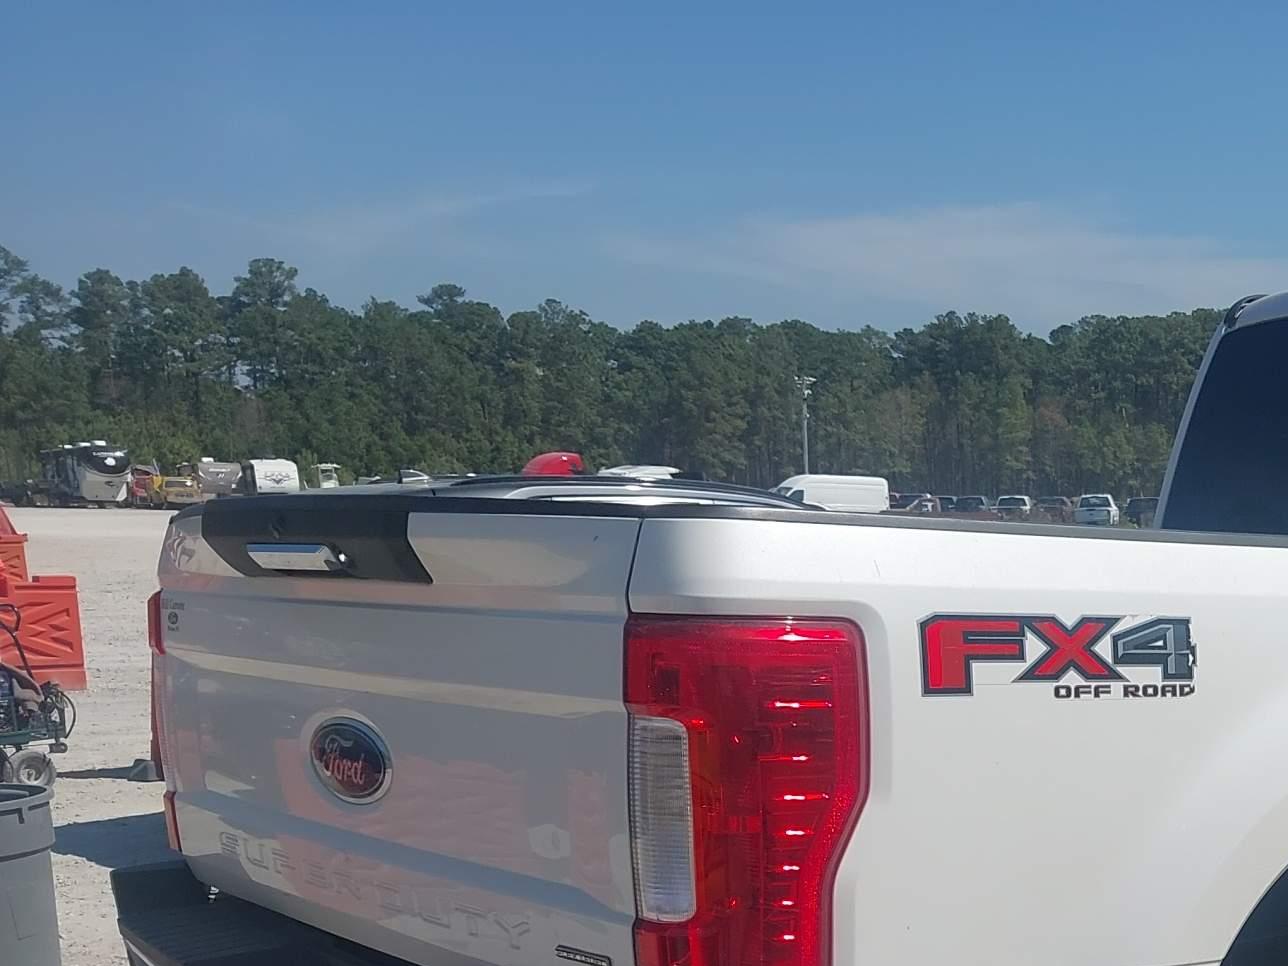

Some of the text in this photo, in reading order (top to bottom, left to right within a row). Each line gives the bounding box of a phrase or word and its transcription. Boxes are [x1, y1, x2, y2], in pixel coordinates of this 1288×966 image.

[916, 612, 1197, 697] FX4
[1053, 684, 1195, 699] OFF ROAD
[321, 734, 366, 784] Ford
[219, 831, 532, 950] SUPER DUTY
